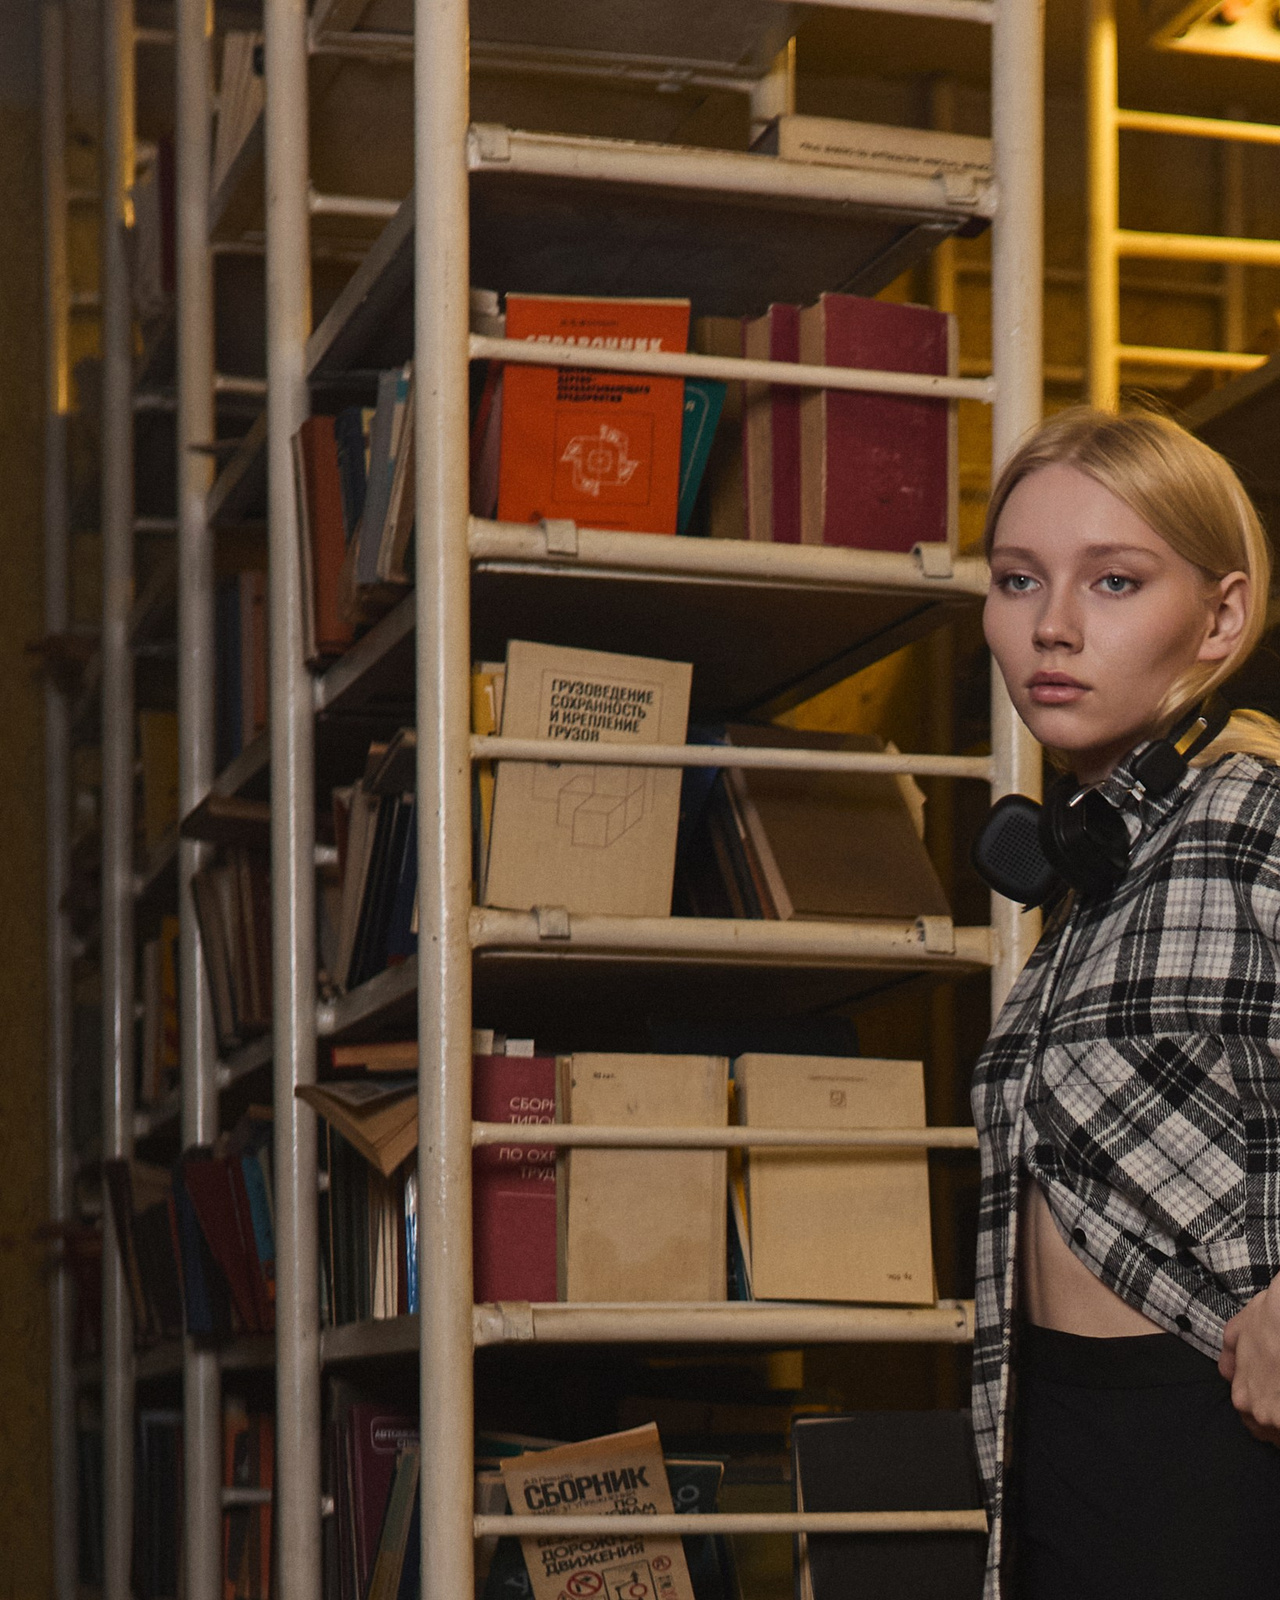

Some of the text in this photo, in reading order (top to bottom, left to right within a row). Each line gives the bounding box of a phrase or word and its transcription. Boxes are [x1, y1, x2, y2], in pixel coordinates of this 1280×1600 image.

[551, 679, 654, 704] ГРУЗОВЕДЕНИЕ
[551, 695, 647, 719] СОХРАННОСТЬ
[550, 710, 640, 733] И КРЕПЛЕНИЕ
[498, 1147, 523, 1161] ПО
[524, 1467, 650, 1510] СБОРНИК
[614, 1497, 638, 1509] ПО
[545, 1541, 645, 1577] ДВИЖЕНИЯ
